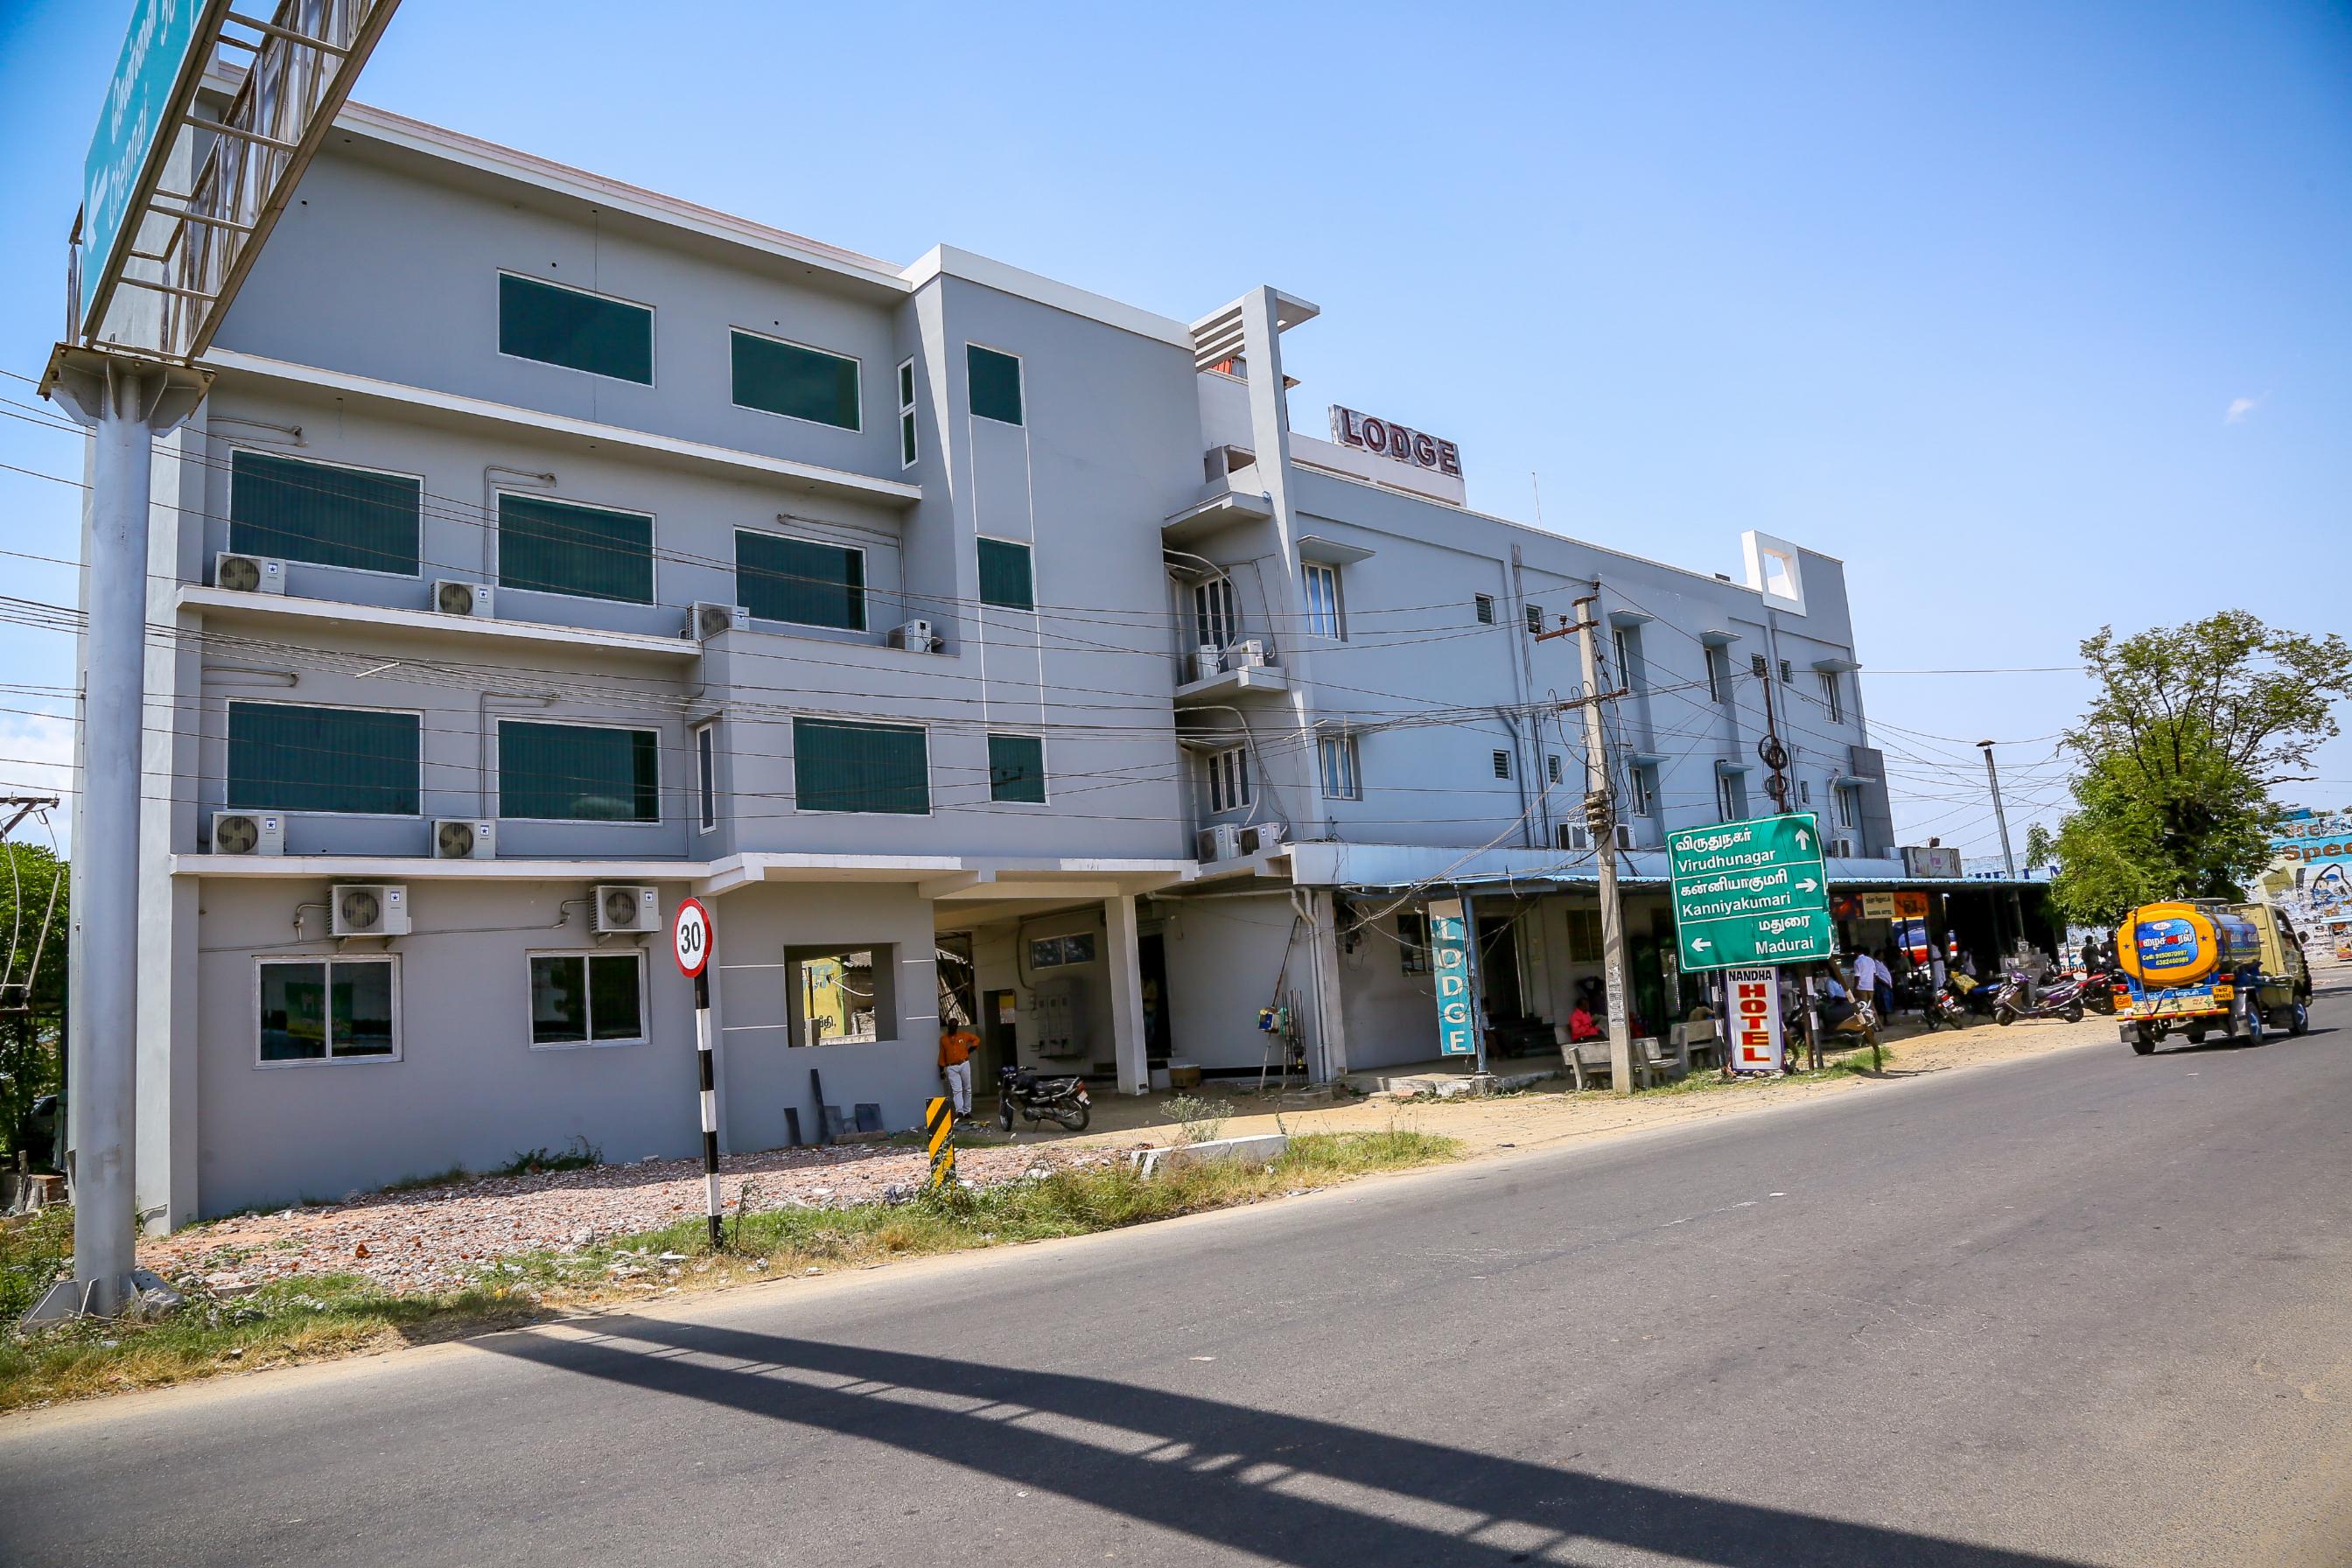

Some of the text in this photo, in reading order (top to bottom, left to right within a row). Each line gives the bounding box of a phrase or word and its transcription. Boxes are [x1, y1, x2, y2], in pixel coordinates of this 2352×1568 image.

[108, 81, 148, 231] Chennai
[1341, 408, 1459, 475] LODGE
[1675, 827, 1753, 852] விருதுநகர்
[1677, 849, 1776, 873] Virudhunagar
[1680, 868, 1788, 897] கன்னியாகுமரி
[1682, 891, 1791, 917] Kanniyakumari
[681, 921, 701, 955] 30
[1758, 915, 1811, 934] மதுரை
[1755, 935, 1814, 955] Madurai
[1438, 918, 1467, 1053] LODGE
[1728, 970, 1773, 981] NANDHA
[1738, 984, 1771, 1062] HOTEL
